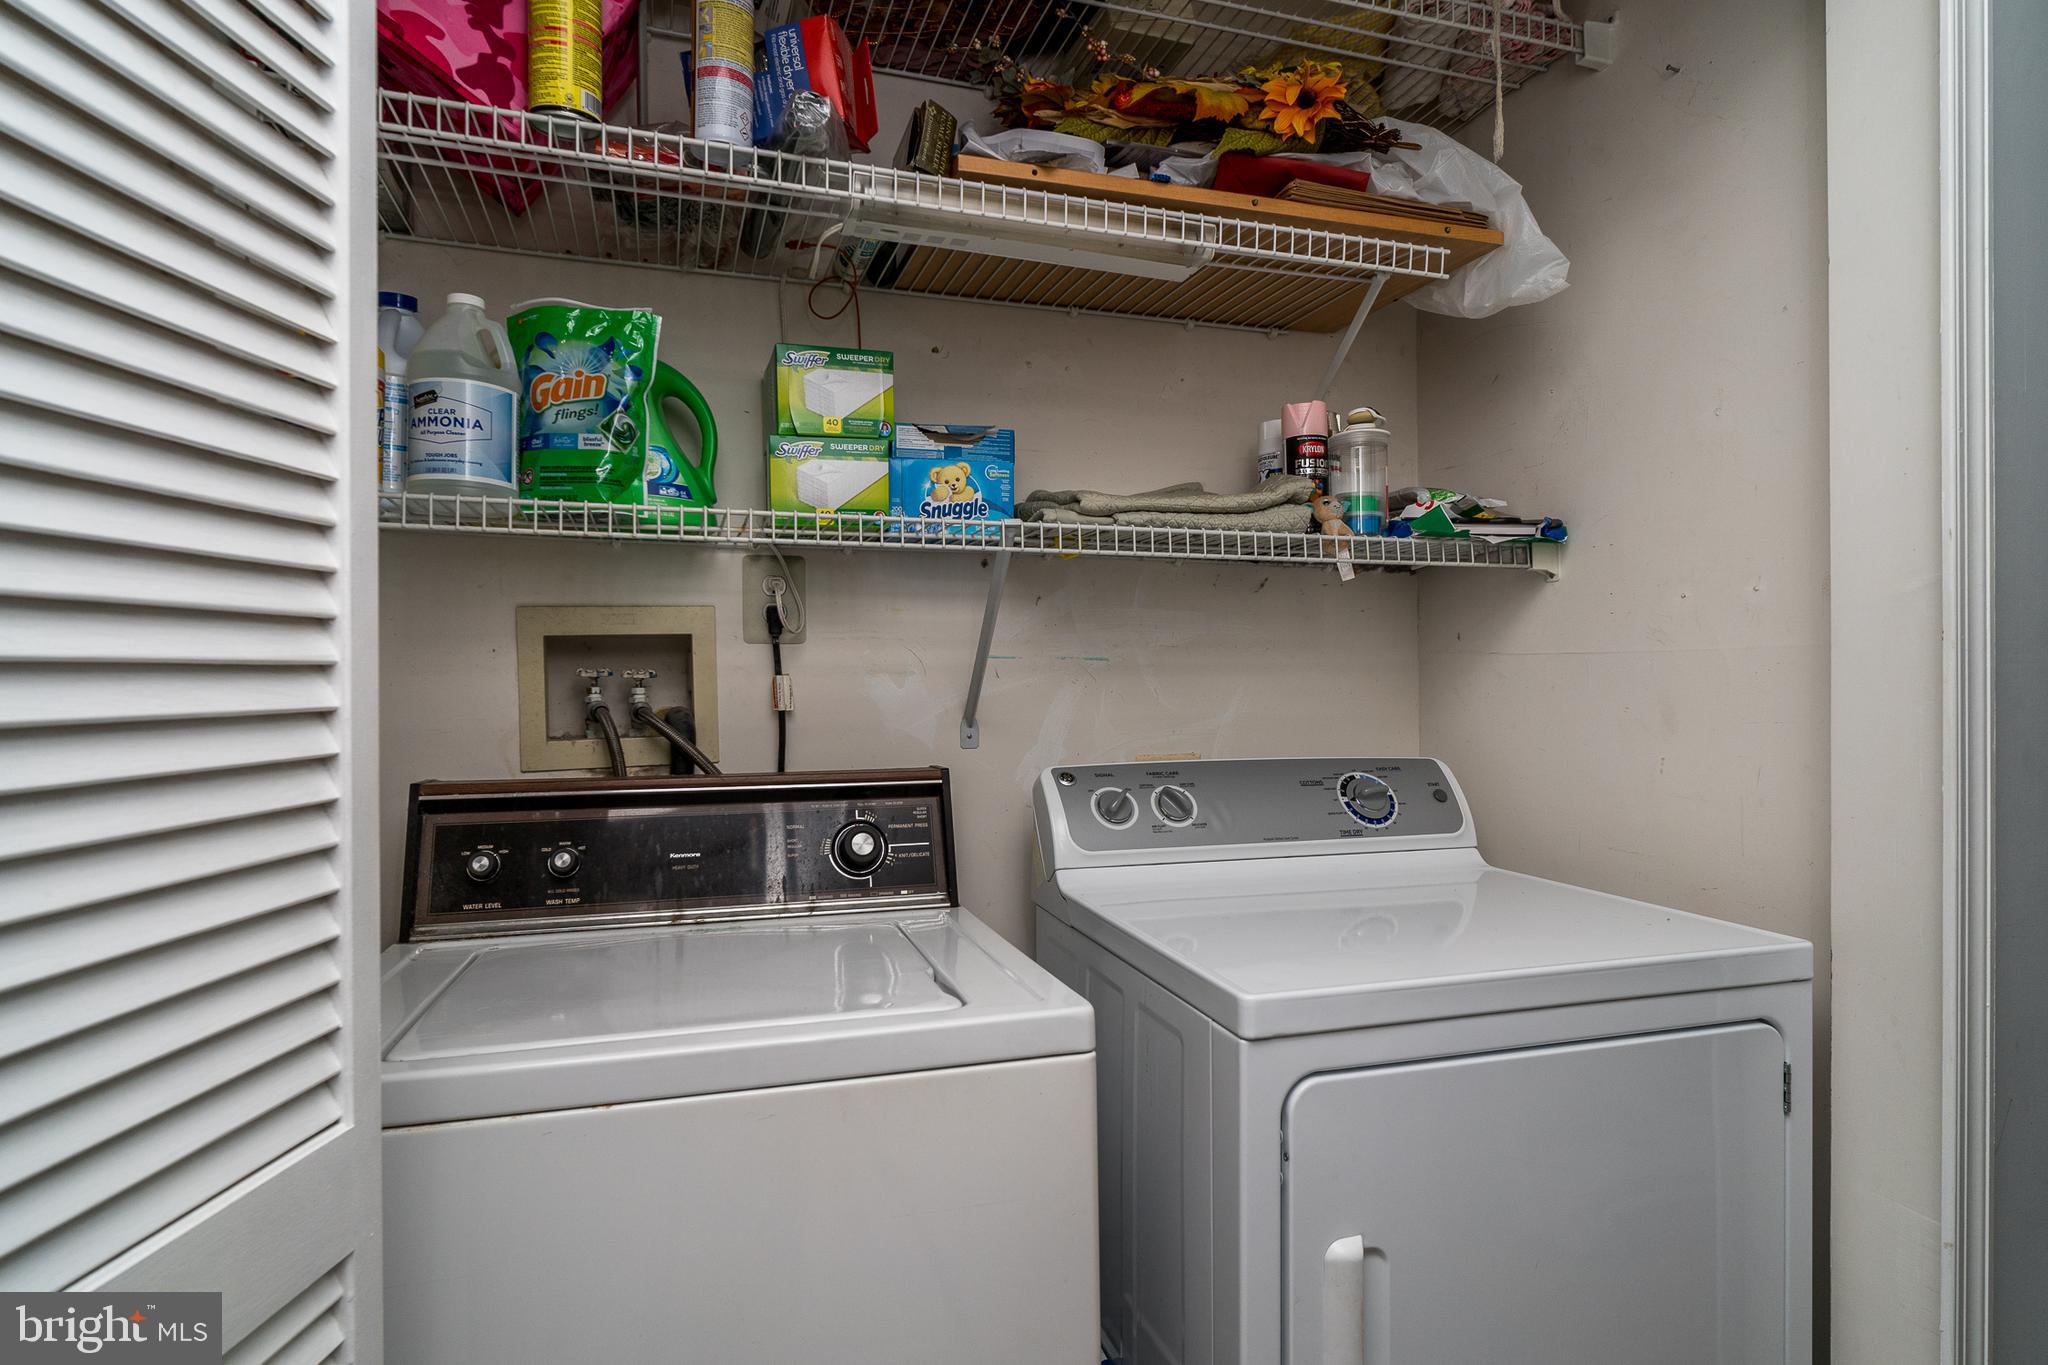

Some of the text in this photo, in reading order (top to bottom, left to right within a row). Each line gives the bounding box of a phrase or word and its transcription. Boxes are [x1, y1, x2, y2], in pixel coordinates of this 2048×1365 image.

[778, 30, 789, 65] flexible
[788, 28, 804, 71] universal
[782, 64, 795, 91] dryer
[782, 351, 829, 368] Swiffer
[836, 354, 873, 362] SWEEPER
[530, 368, 606, 412] Gain
[411, 416, 483, 431] AMMONIA
[552, 404, 599, 424] flings!
[776, 442, 822, 459] Swiffer
[921, 498, 988, 519] Snuggle
